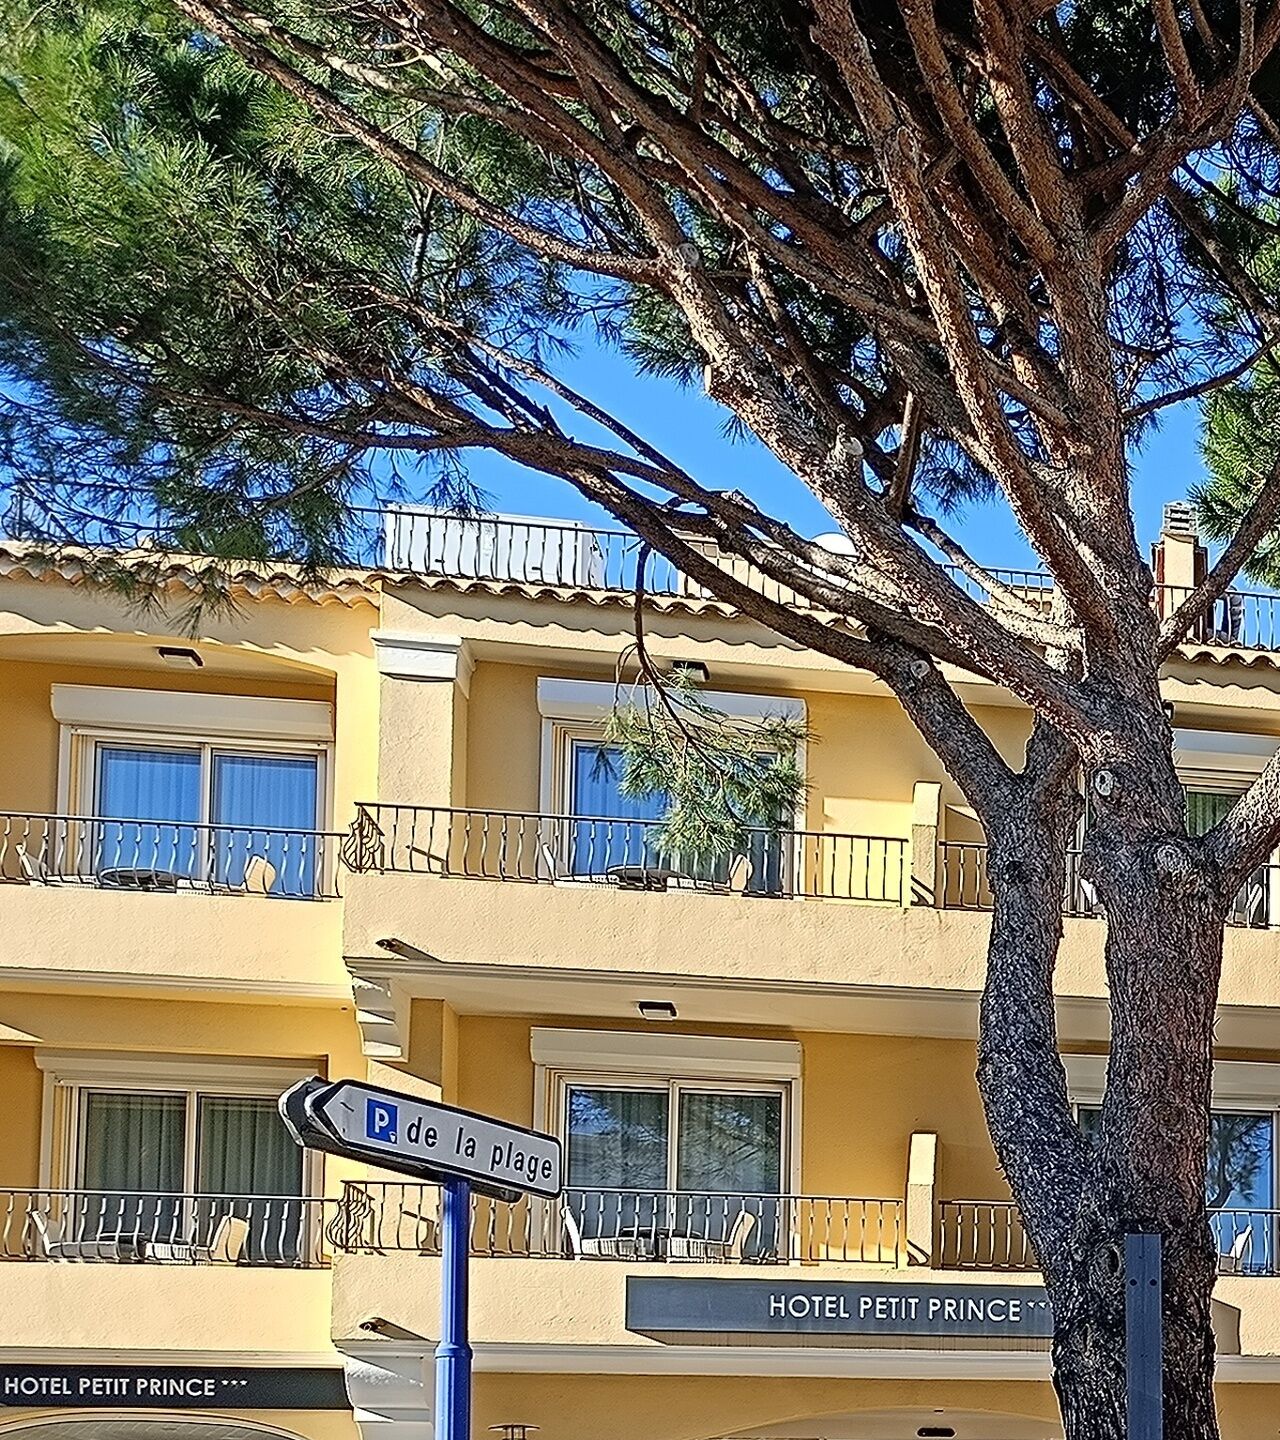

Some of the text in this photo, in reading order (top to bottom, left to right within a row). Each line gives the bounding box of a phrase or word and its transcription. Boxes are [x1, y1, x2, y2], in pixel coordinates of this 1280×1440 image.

[407, 1116, 438, 1147] de
[455, 1127, 477, 1158] la
[490, 1141, 552, 1182] plage
[769, 1295, 1021, 1322] HOTEL PETIT PRINCE
[4, 1377, 215, 1396] HOTEL PETIT PRINCE
